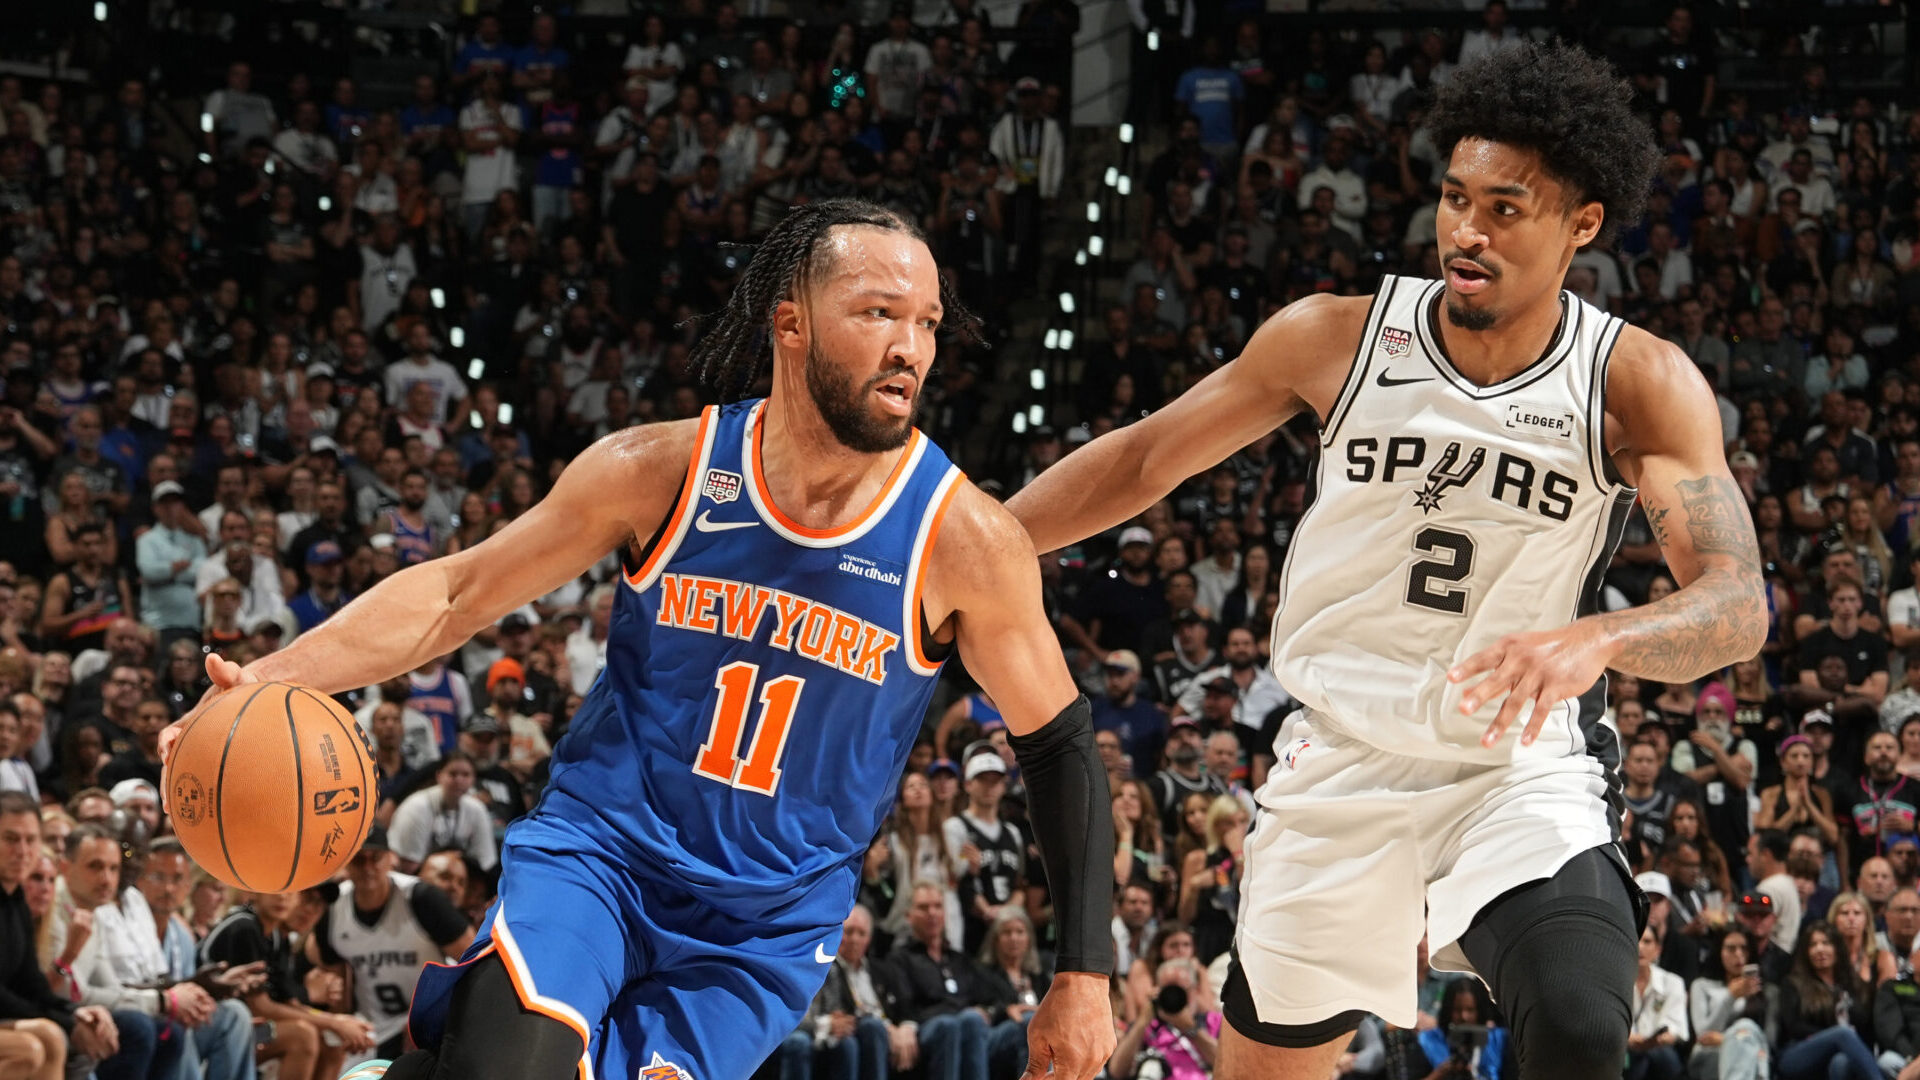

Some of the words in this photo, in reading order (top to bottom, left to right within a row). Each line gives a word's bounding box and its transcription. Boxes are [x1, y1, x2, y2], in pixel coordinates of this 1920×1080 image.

[1385, 328, 1408, 340] USA
[1379, 340, 1407, 352] 250
[1515, 412, 1564, 430] LEDGER
[710, 473, 737, 485] USA
[1347, 437, 1578, 521] SPURS
[705, 485, 735, 498] 250
[843, 553, 877, 567] experience
[838, 561, 864, 576] abu
[864, 567, 902, 586] dhabi
[1402, 522, 1478, 618] 2
[656, 573, 775, 642] NEW
[769, 589, 901, 686] YORK
[692, 660, 806, 797] 11
